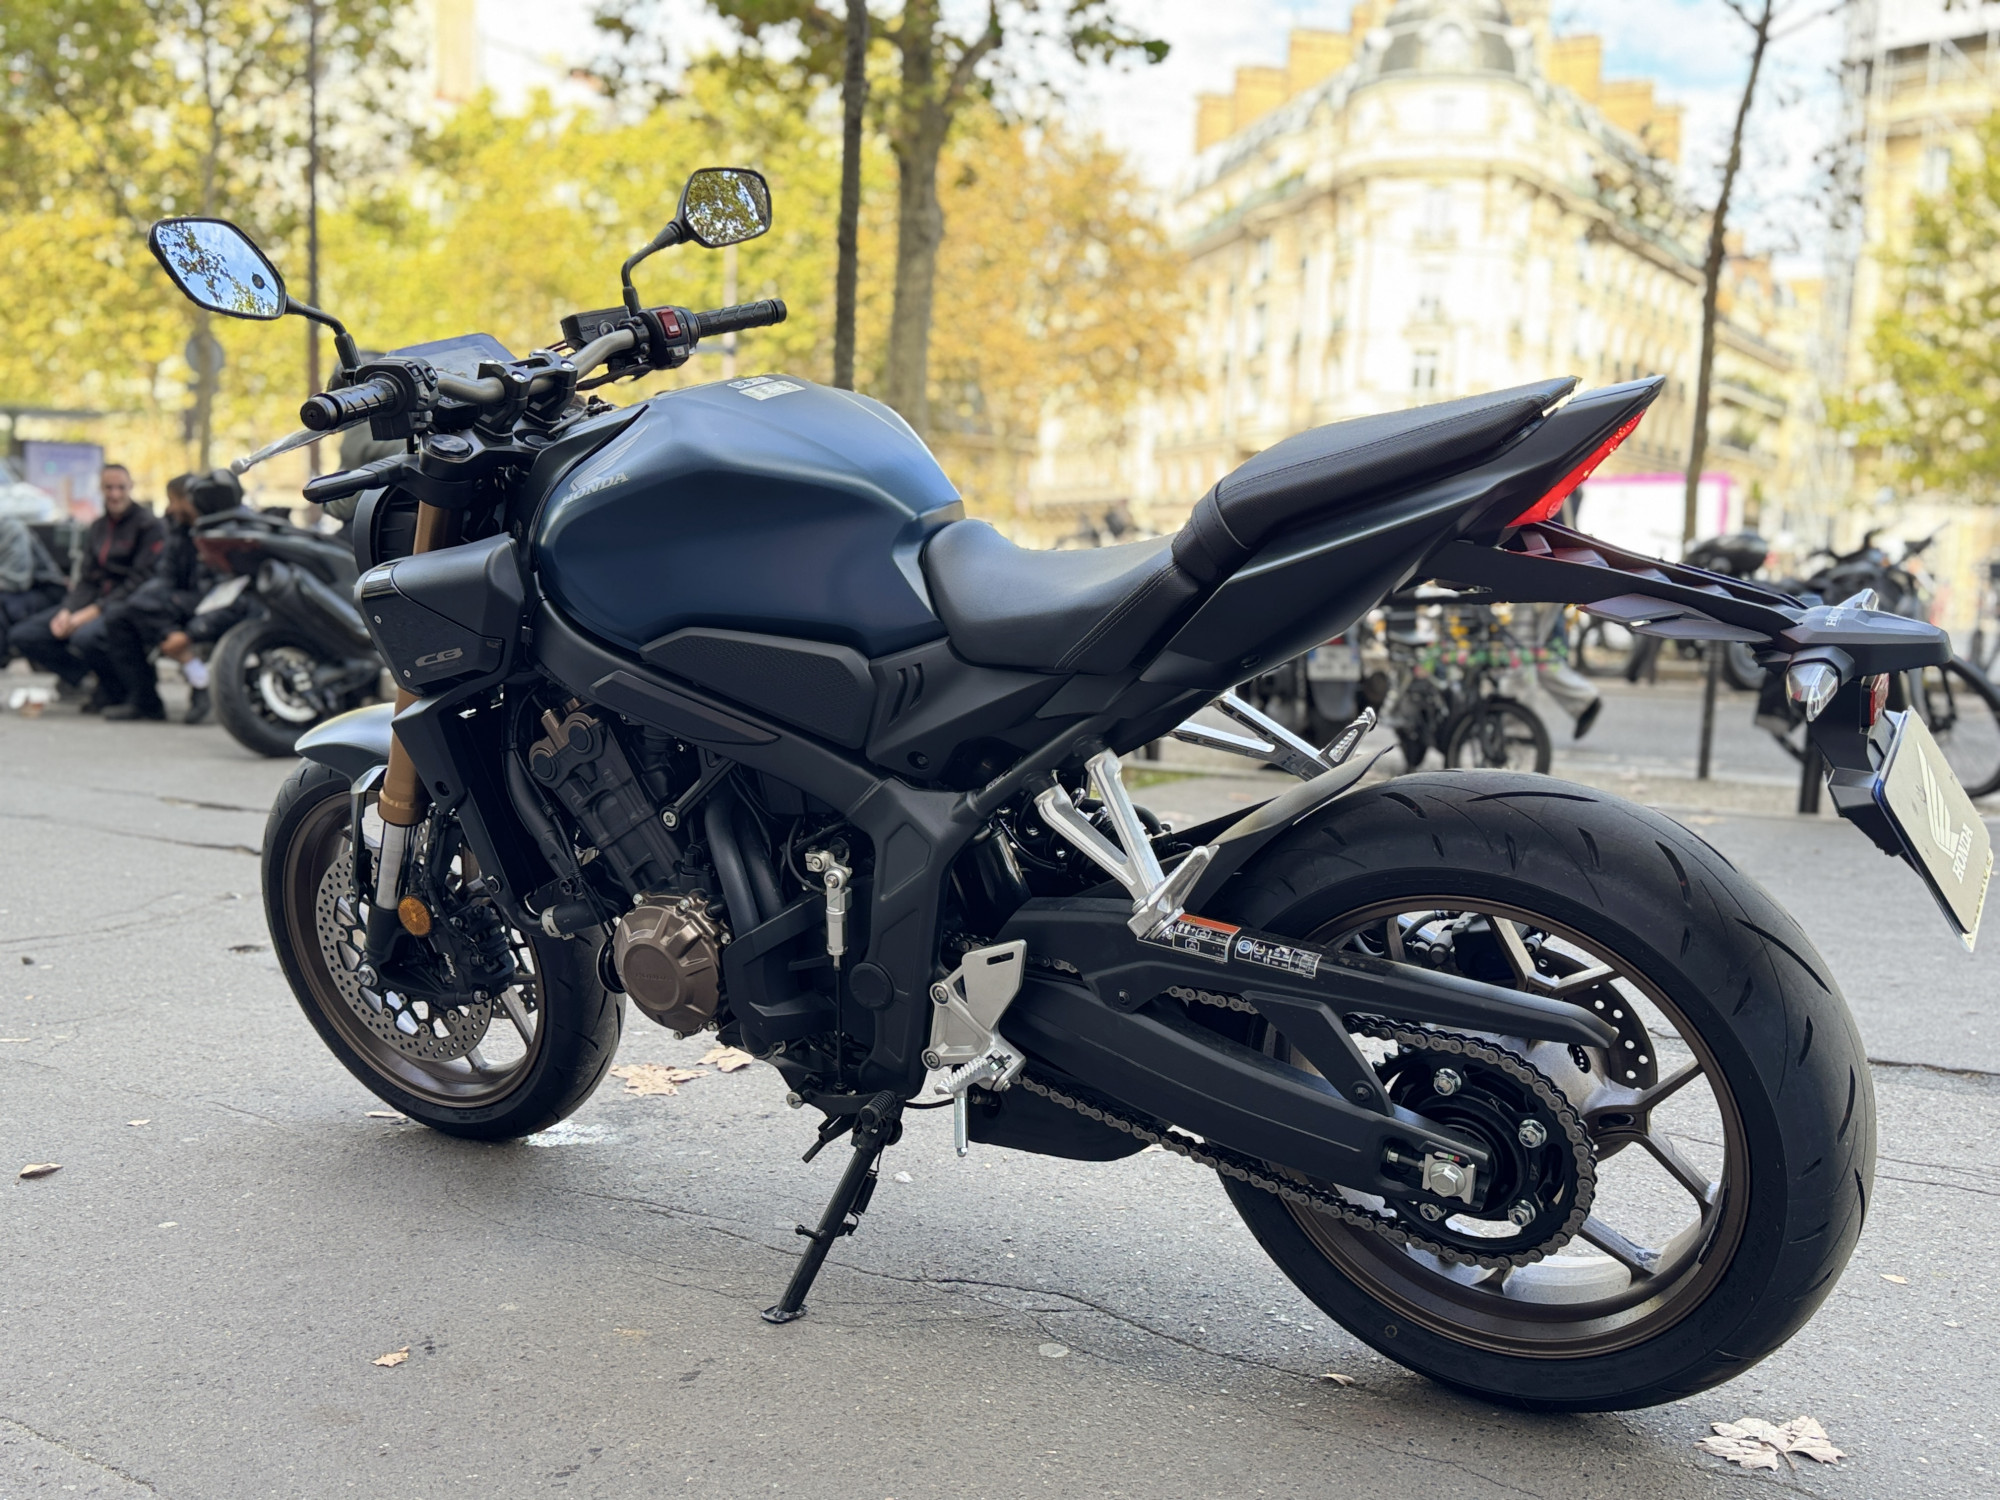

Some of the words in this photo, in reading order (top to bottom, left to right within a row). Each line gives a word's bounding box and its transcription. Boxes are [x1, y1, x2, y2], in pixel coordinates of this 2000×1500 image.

[560, 472, 629, 506] HONDA
[415, 647, 463, 667] CB
[1952, 822, 1974, 885] HONDA
